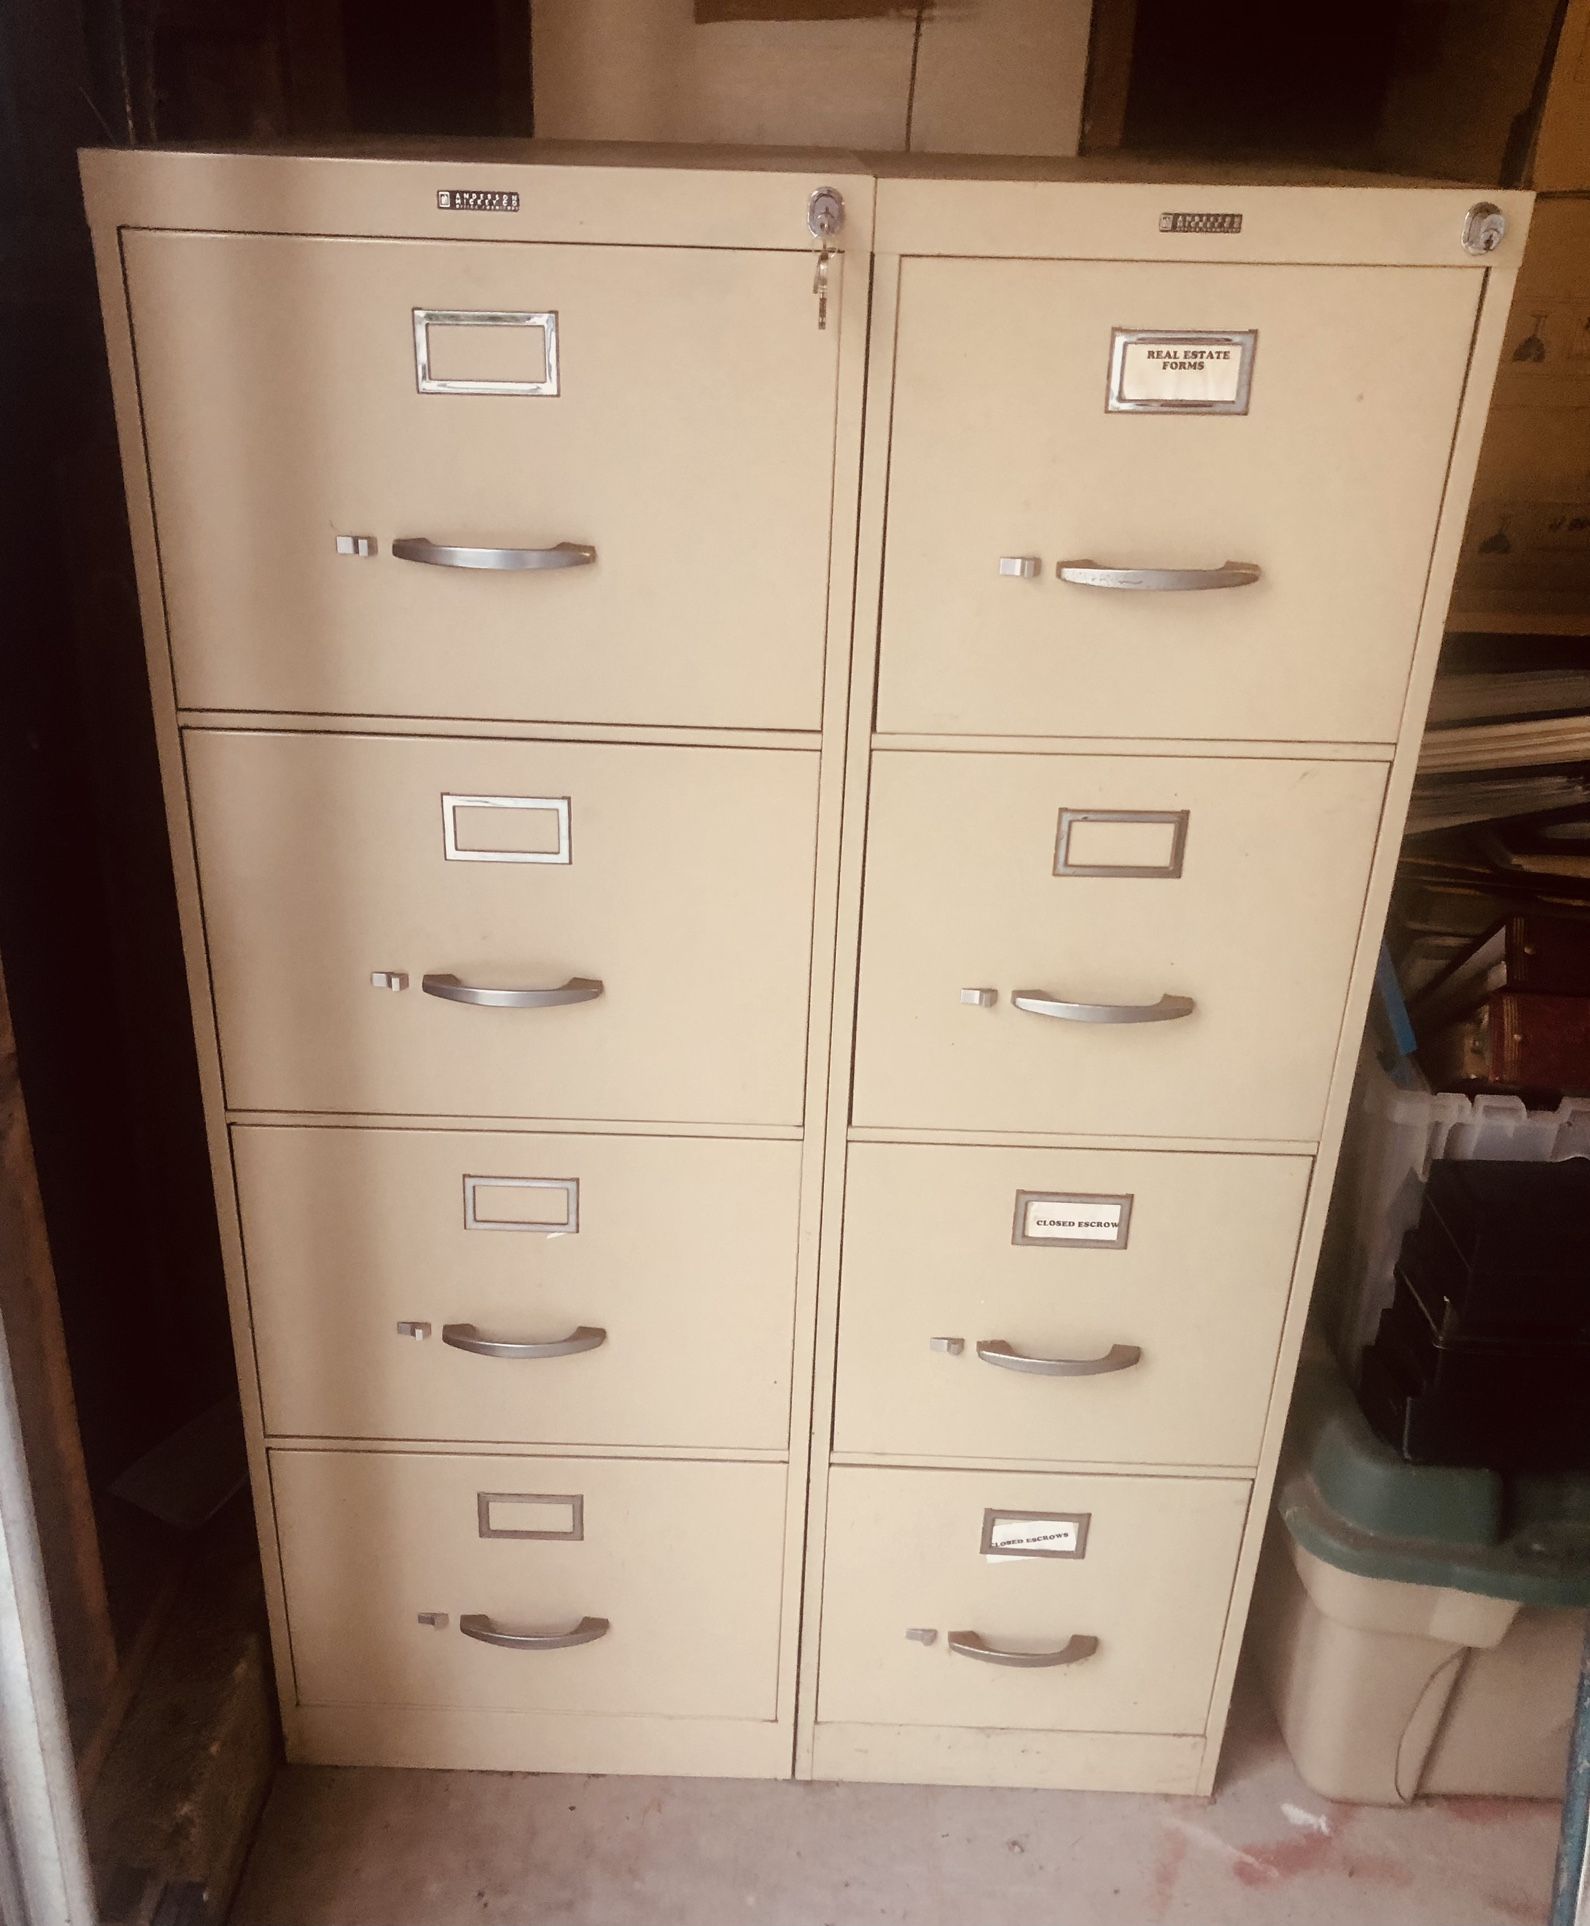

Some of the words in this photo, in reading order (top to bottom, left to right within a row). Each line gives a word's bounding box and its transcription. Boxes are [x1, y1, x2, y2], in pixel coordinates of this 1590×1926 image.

[455, 192, 518, 201] ANDERSON
[1147, 350, 1180, 360] REAL
[1183, 350, 1231, 360] ESTATE
[1162, 361, 1205, 371] FORMS
[1036, 1219, 1075, 1227] CLOSED
[1026, 1532, 1069, 1543] ESCROWS
